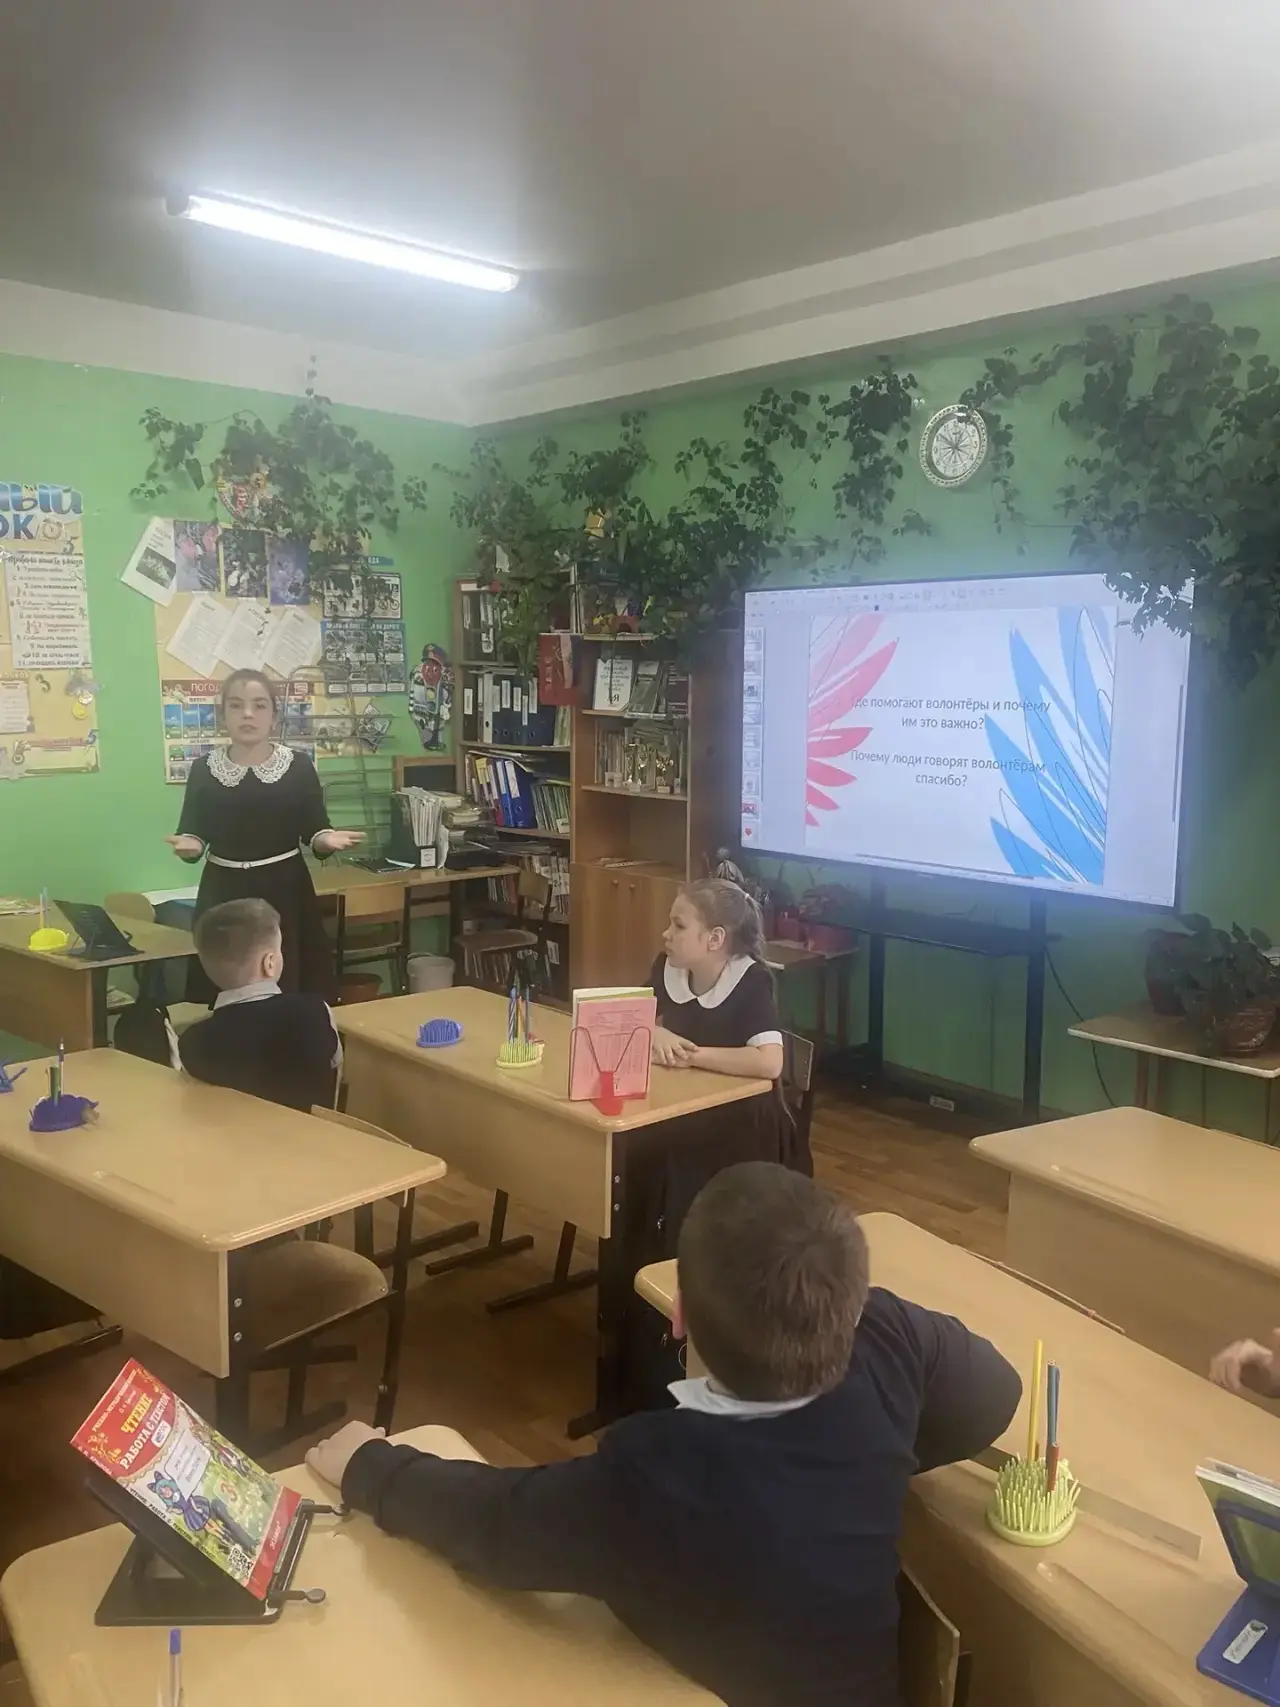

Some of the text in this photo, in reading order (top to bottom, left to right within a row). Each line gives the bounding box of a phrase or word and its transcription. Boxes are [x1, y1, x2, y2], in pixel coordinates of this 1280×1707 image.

[871, 698, 922, 709] помогают
[926, 697, 989, 712] волонтёры
[993, 701, 1000, 711] и
[1003, 701, 1051, 712] почему
[901, 717, 984, 730] им это важно?
[850, 750, 1046, 774] Почему люди говорят волонтёрам
[916, 772, 968, 787] спасибо?
[121, 1393, 153, 1433] ЧТЕНИЕ
[120, 1427, 151, 1470] РАБОТА
[145, 1420, 155, 1430] С
[150, 1392, 171, 1425] ТЕКСТОМ
[220, 1481, 238, 1502] 3
[149, 1503, 166, 1519] РАБОТА
